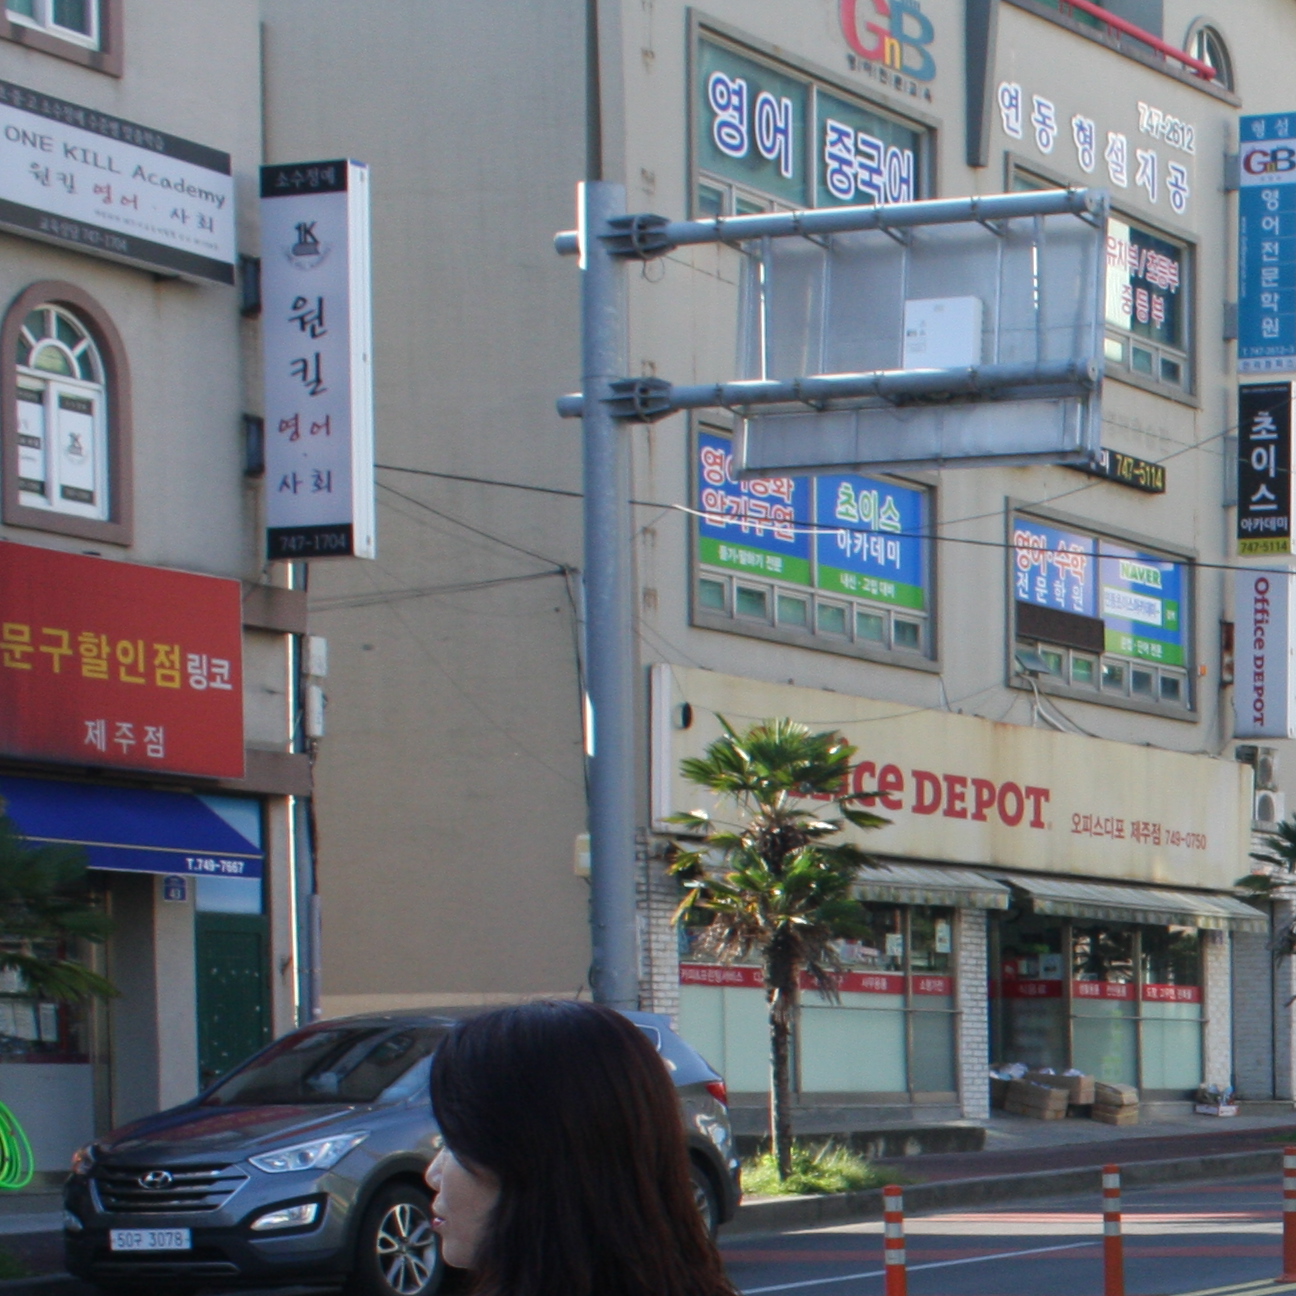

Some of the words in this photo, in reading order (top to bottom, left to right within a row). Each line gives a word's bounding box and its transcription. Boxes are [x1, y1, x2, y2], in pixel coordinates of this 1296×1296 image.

[708, 71, 793, 179] 영어
[824, 118, 914, 205] 중국어
[5, 125, 53, 152] ONE
[64, 142, 121, 174] KILL
[132, 165, 226, 209] Academy
[274, 168, 336, 189] 소수정예
[1243, 148, 1296, 175] GnB
[30, 162, 76, 194] 원킬
[93, 184, 138, 210] 영어
[170, 208, 214, 233] 사회
[1260, 188, 1279, 339] 영어전문학원
[287, 295, 329, 397] 원킬
[279, 414, 331, 439] 영어
[279, 471, 333, 496] 사회
[1249, 411, 1278, 511] 초이스
[836, 482, 902, 532] 초이스
[1240, 515, 1288, 533] 아카데미
[279, 531, 347, 552] 747-1704
[837, 529, 901, 570] 아카데미
[1239, 539, 1288, 554] 747-5114
[1254, 577, 1271, 650] Office
[0, 622, 182, 689] 문구할인점
[187, 653, 233, 691] 링코
[1253, 656, 1266, 728] DEPOT
[84, 719, 165, 758] 제주점
[911, 770, 1051, 830] DEPOT
[1071, 811, 1125, 840] 오피스디포
[1130, 820, 1162, 846] 제주점
[1165, 828, 1206, 851] 749-0750
[149, 1231, 183, 1247] 3078
